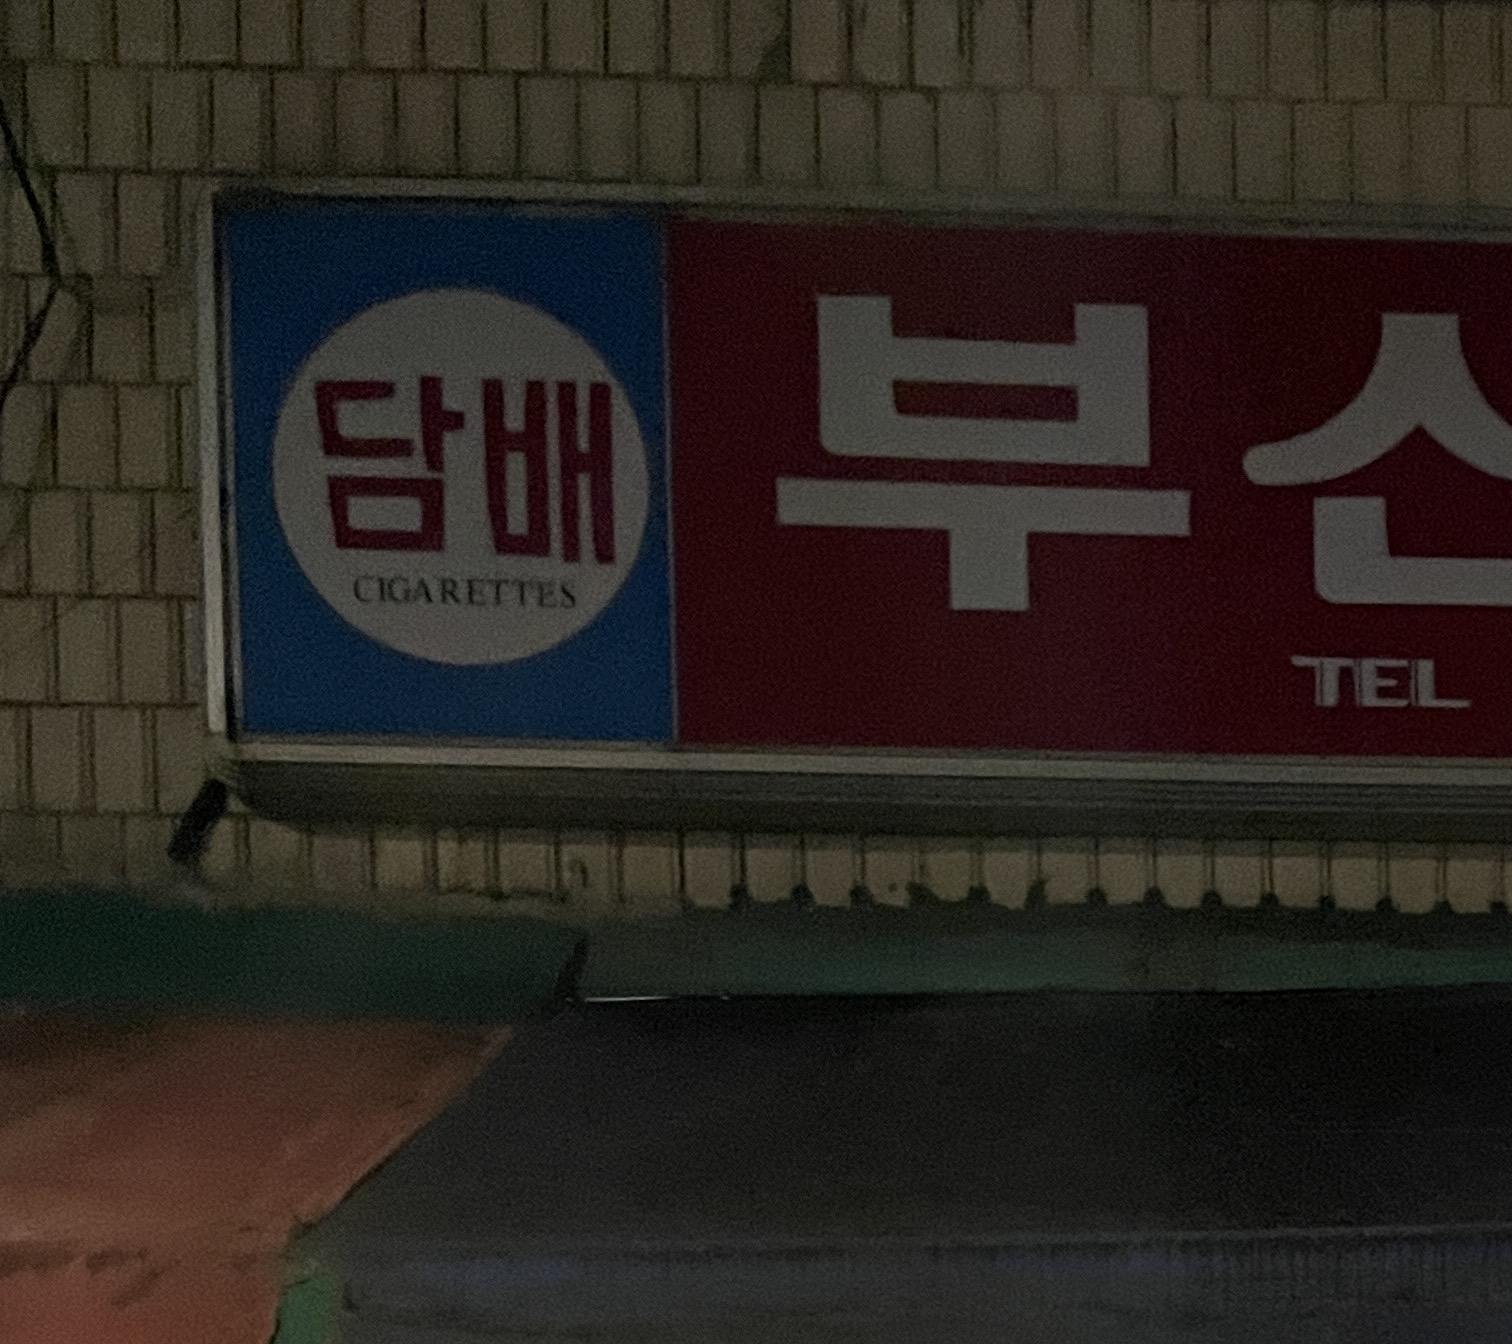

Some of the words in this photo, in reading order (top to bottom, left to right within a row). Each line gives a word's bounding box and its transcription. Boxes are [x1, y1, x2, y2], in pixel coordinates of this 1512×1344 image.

[314, 376, 616, 565] 담배
[352, 573, 578, 609] CIGARETTES
[1290, 655, 1472, 708] TEL
